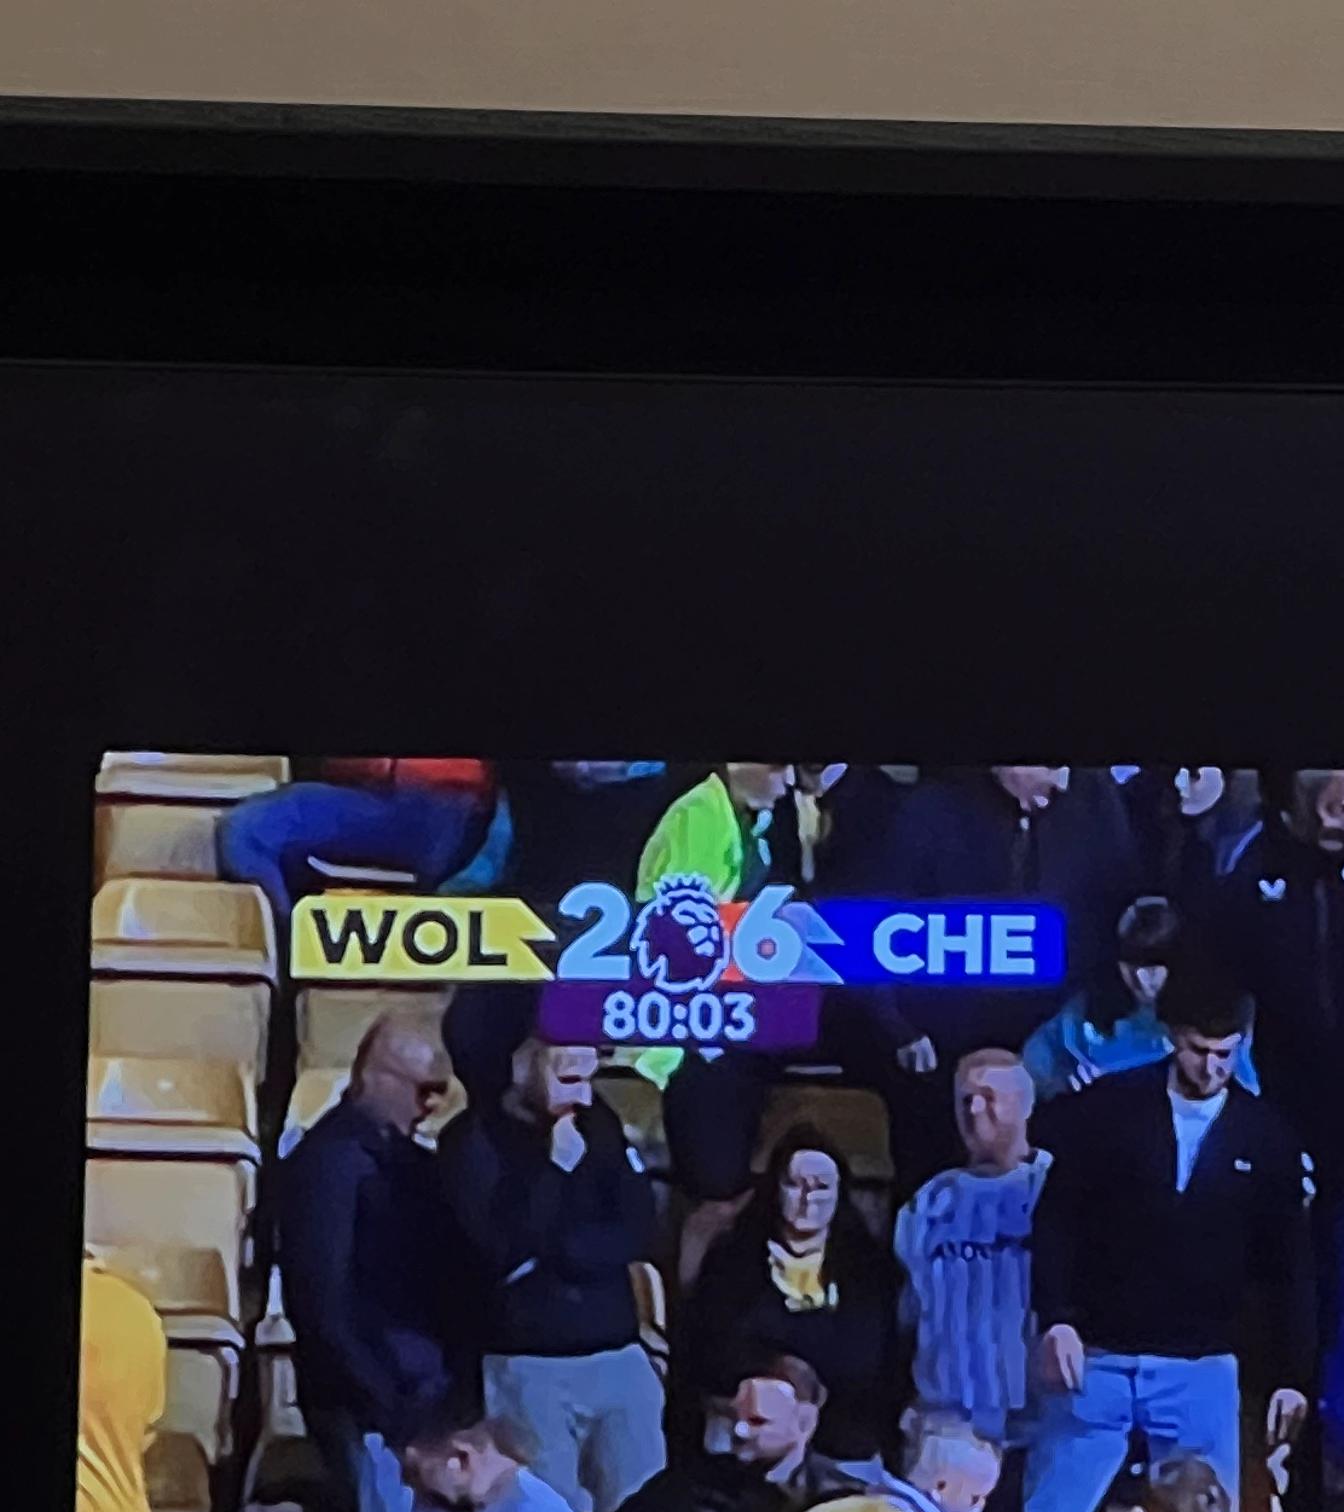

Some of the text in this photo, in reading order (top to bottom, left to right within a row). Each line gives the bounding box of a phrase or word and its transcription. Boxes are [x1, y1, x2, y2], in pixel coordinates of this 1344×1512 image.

[311, 883, 1036, 983] WOL 2 6 CHE
[602, 996, 756, 1041] 80:03
